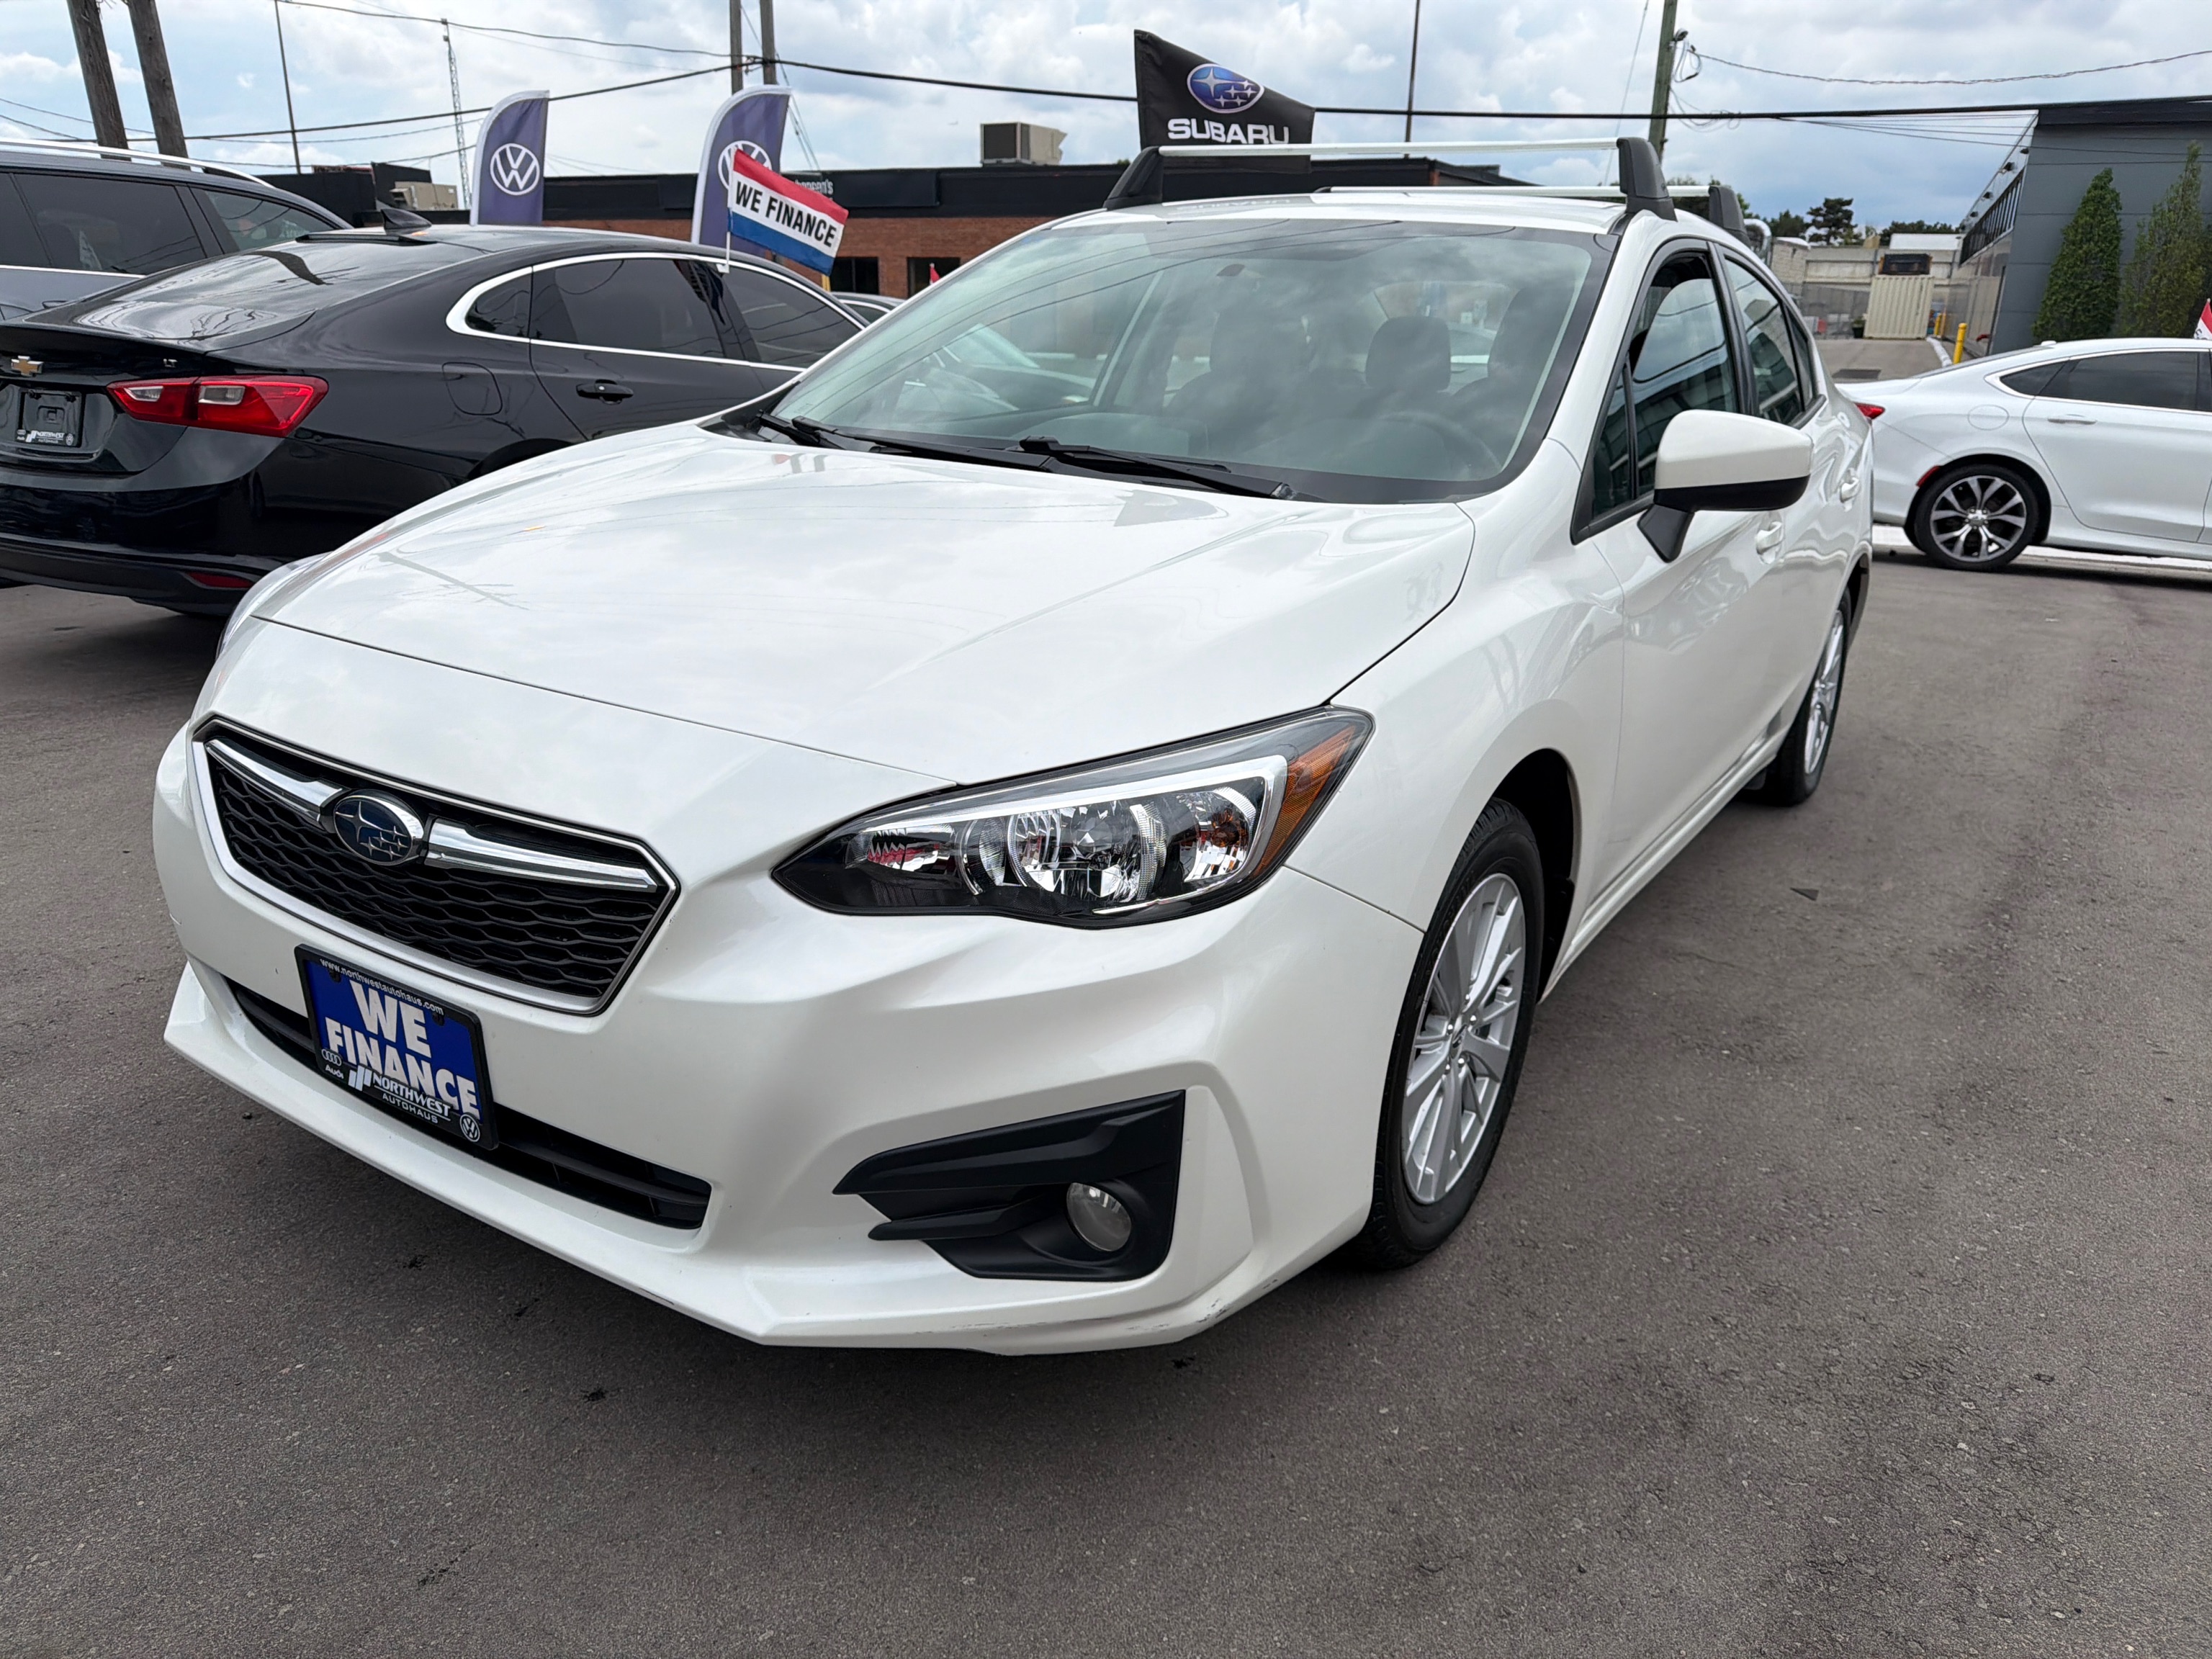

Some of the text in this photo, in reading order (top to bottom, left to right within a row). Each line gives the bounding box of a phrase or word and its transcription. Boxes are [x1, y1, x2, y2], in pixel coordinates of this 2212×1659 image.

[1167, 118, 1290, 145] SUBARU
[735, 181, 837, 248] WE FINANCE
[319, 958, 444, 1015] www.northwestautohaus.com
[349, 979, 432, 1058] WE
[325, 1016, 480, 1120] FINANCE
[373, 1071, 451, 1117] NORTHWEST
[382, 1093, 439, 1124] AUTOHAUS
